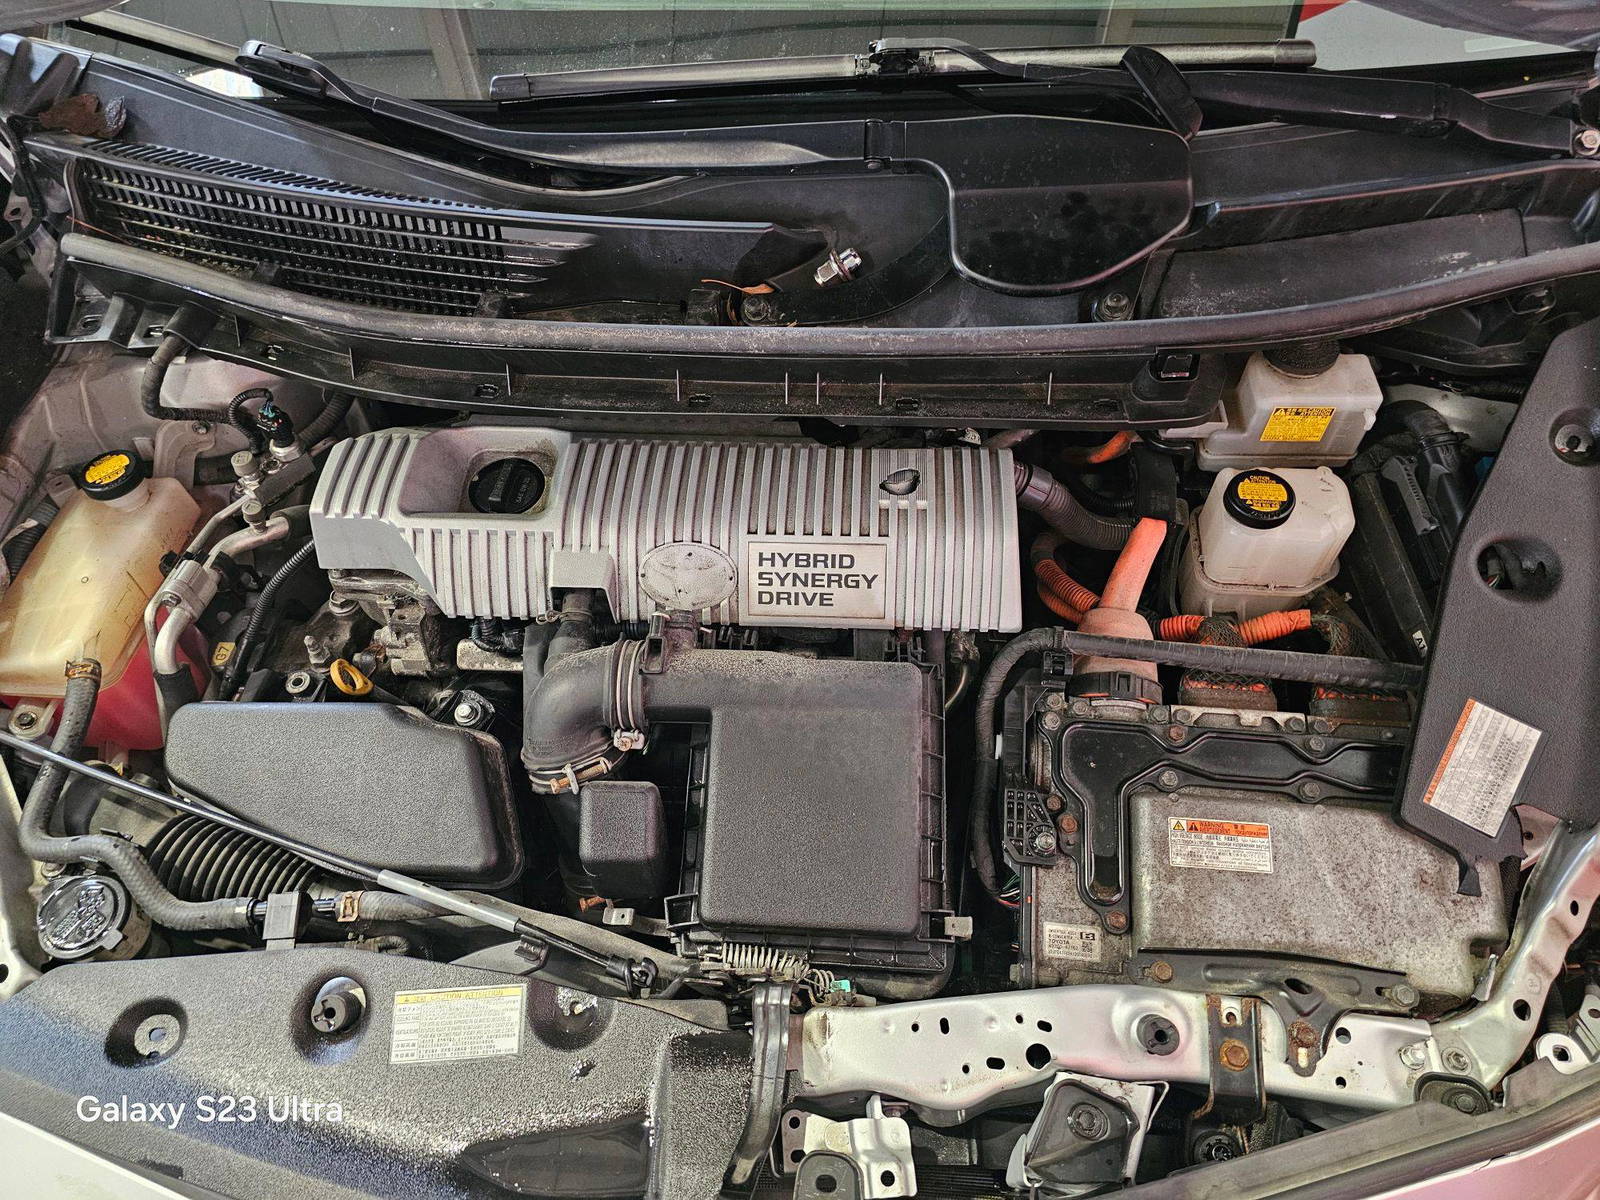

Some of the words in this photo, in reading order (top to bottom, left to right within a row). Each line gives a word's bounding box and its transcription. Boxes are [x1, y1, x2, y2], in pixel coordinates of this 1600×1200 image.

[758, 552, 855, 569] HYBRID
[757, 572, 878, 589] SYNERGY
[757, 591, 834, 606] DRIVE
[216, 645, 229, 661] G7
